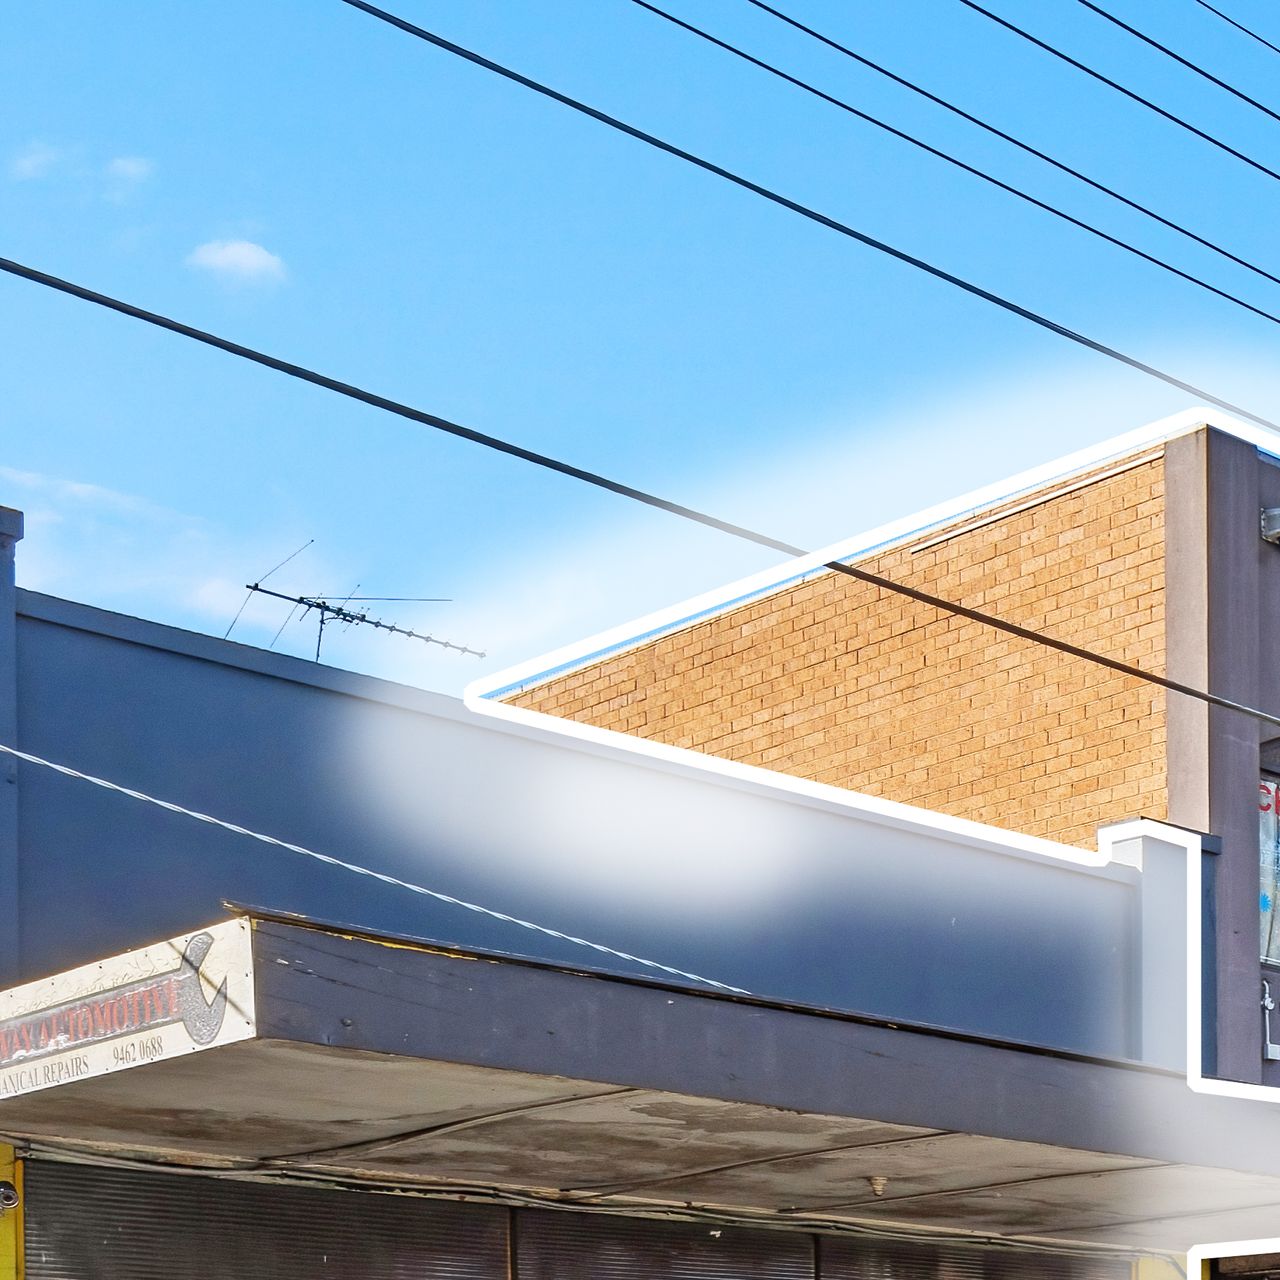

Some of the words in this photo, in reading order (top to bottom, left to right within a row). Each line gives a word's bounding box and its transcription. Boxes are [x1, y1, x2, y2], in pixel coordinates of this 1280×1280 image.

[39, 978, 180, 1046] AUTOMOTIVE
[0, 1067, 41, 1095] ANICAL
[43, 1055, 90, 1084] REPAIRS
[113, 1043, 137, 1067] 9462
[139, 1036, 164, 1061] 0688
